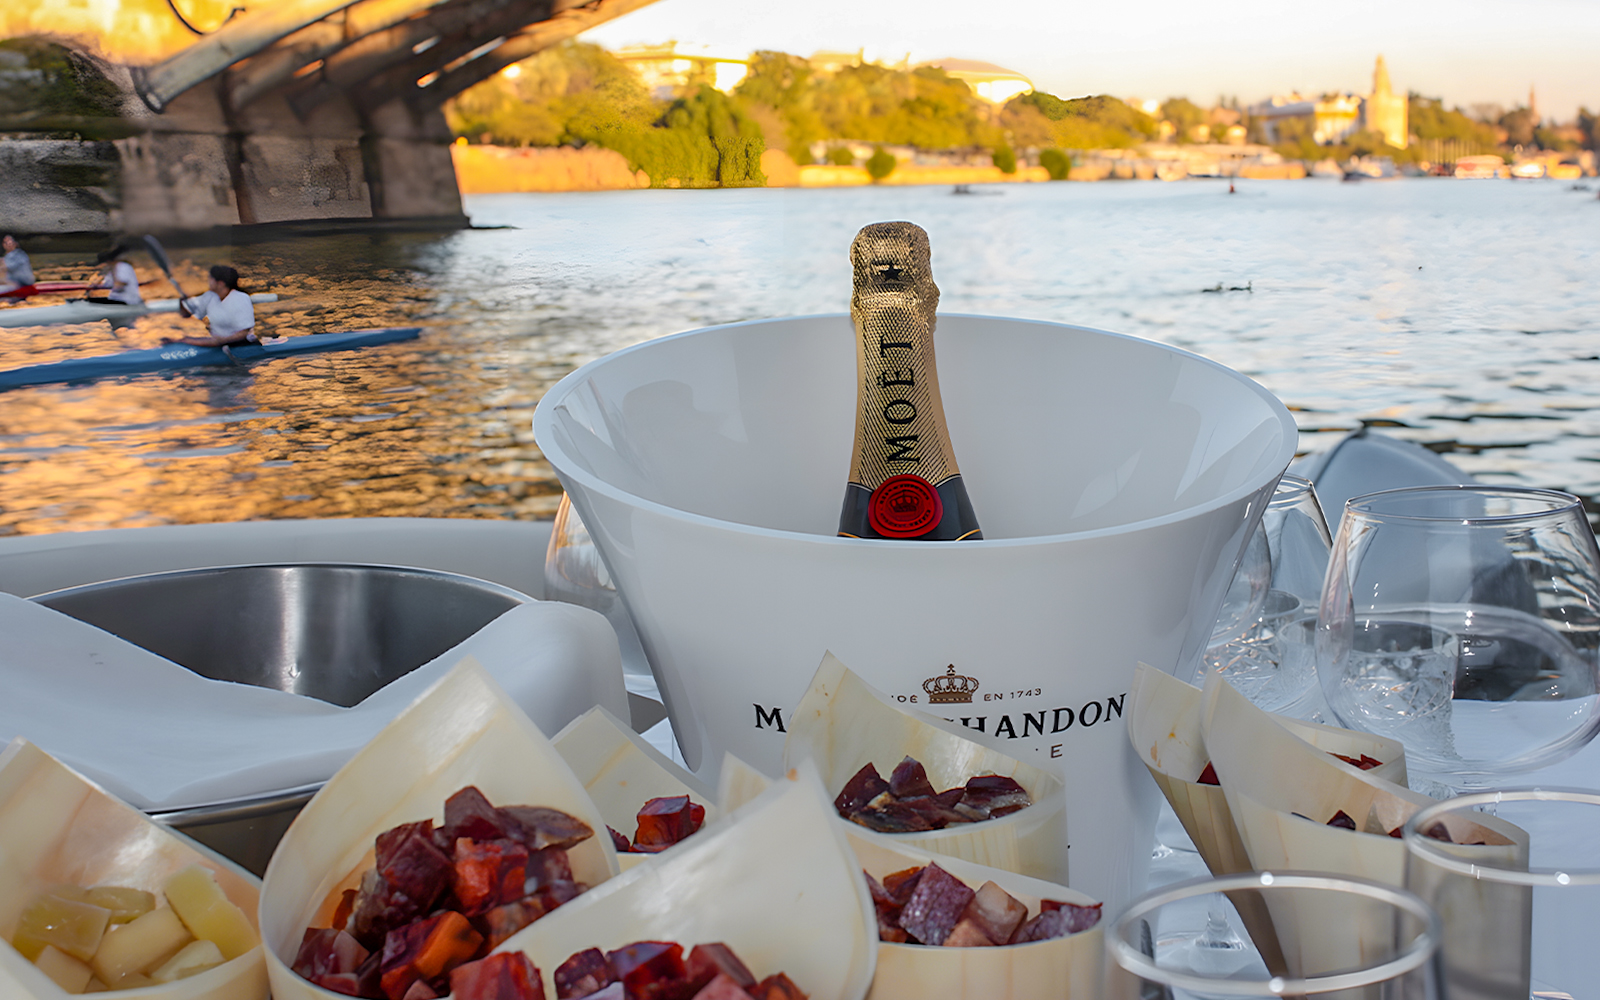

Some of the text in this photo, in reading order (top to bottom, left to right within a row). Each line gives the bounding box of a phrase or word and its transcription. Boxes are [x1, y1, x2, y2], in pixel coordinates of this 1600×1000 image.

[983, 692, 1004, 702] EN
[1010, 687, 1042, 699] 1743
[943, 692, 1127, 740] HANDON
